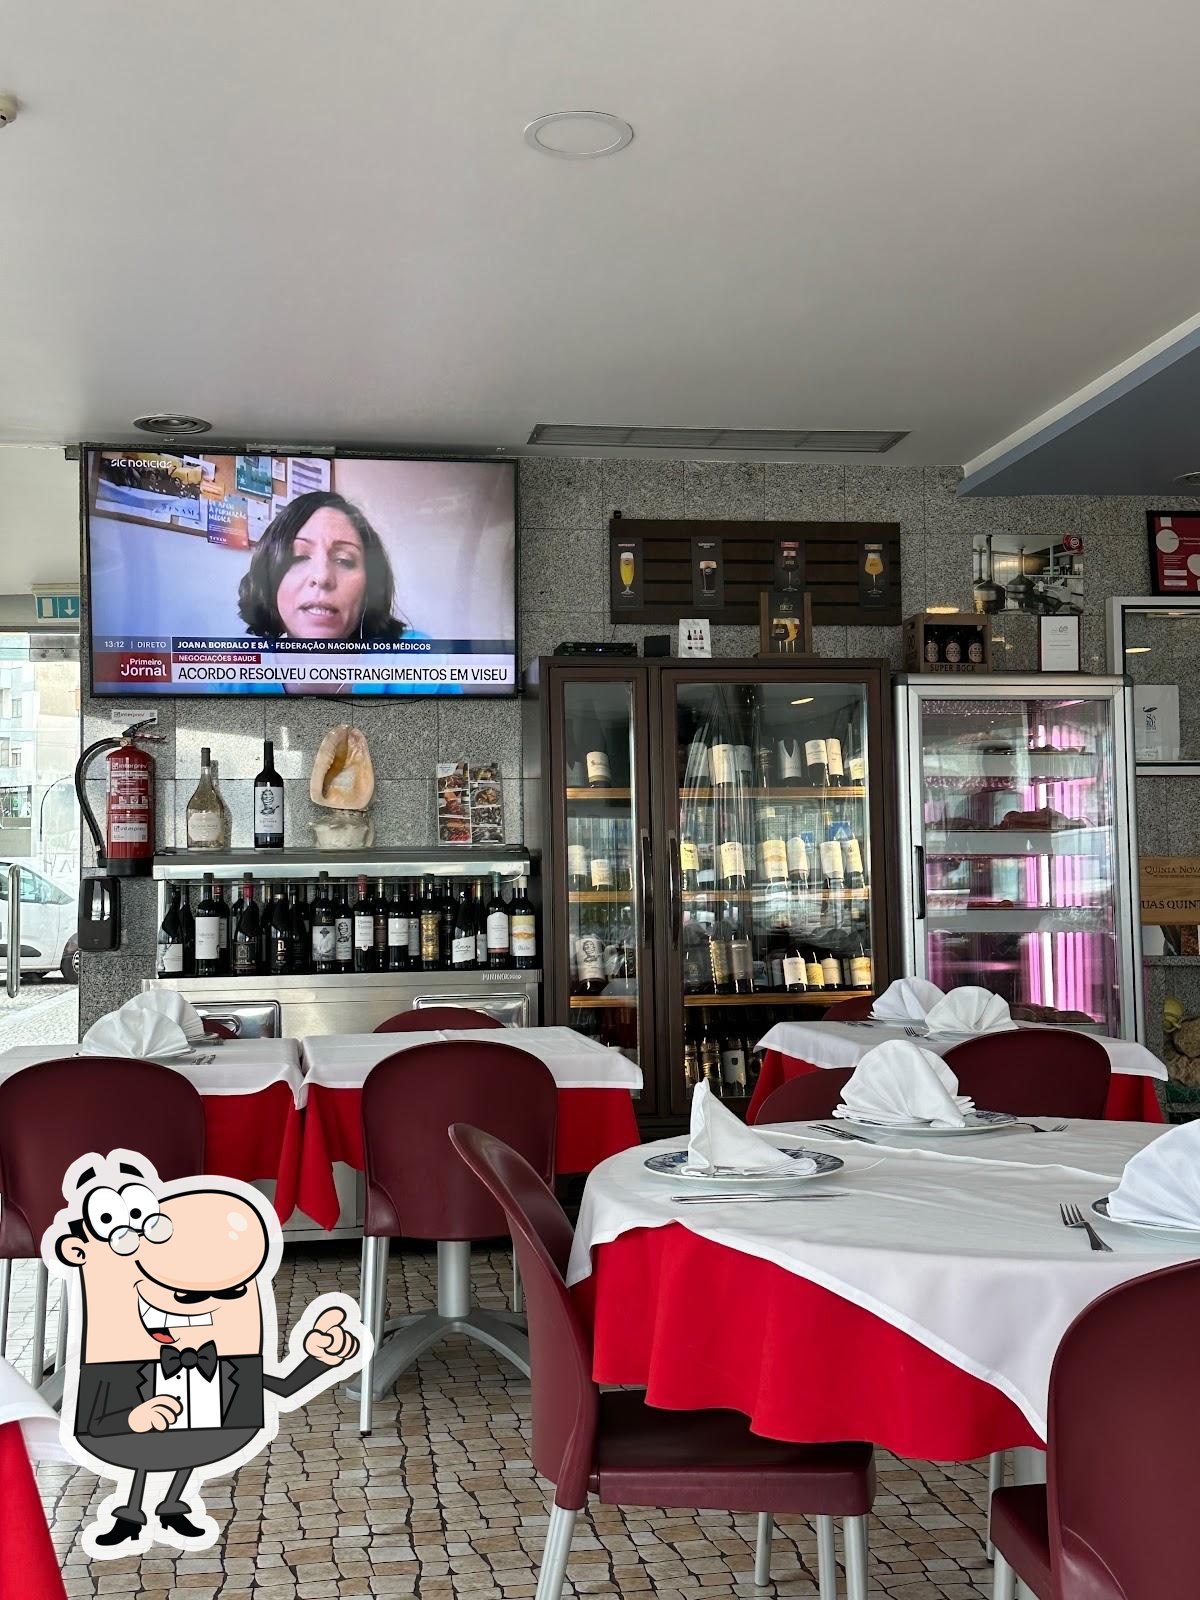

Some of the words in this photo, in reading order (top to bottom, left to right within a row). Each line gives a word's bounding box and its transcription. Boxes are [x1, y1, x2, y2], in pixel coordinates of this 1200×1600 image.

[104, 640, 125, 649] 13:12
[137, 641, 167, 649] DIRETO
[177, 641, 207, 650] JOANA
[208, 641, 250, 650] BORDALO
[250, 641, 257, 650] E
[275, 641, 326, 651] FEDERAÇÃO
[327, 642, 372, 651] NACIONAL
[373, 643, 391, 651] DOS
[392, 641, 432, 651] MÉDICOS
[129, 658, 163, 666] Primeiro
[178, 653, 232, 663] NEGOCIAÇÕES
[120, 664, 168, 677] Jornal
[929, 664, 953, 672] SUPER
[955, 664, 977, 672] BOCK
[178, 667, 236, 680] ACORDO
[239, 667, 306, 681] RESOLVEU
[309, 667, 447, 681] CONSTRANGIMENTOS
[450, 668, 469, 681] EM
[471, 668, 508, 681] VISEU
[1141, 899, 1165, 910] UAS
